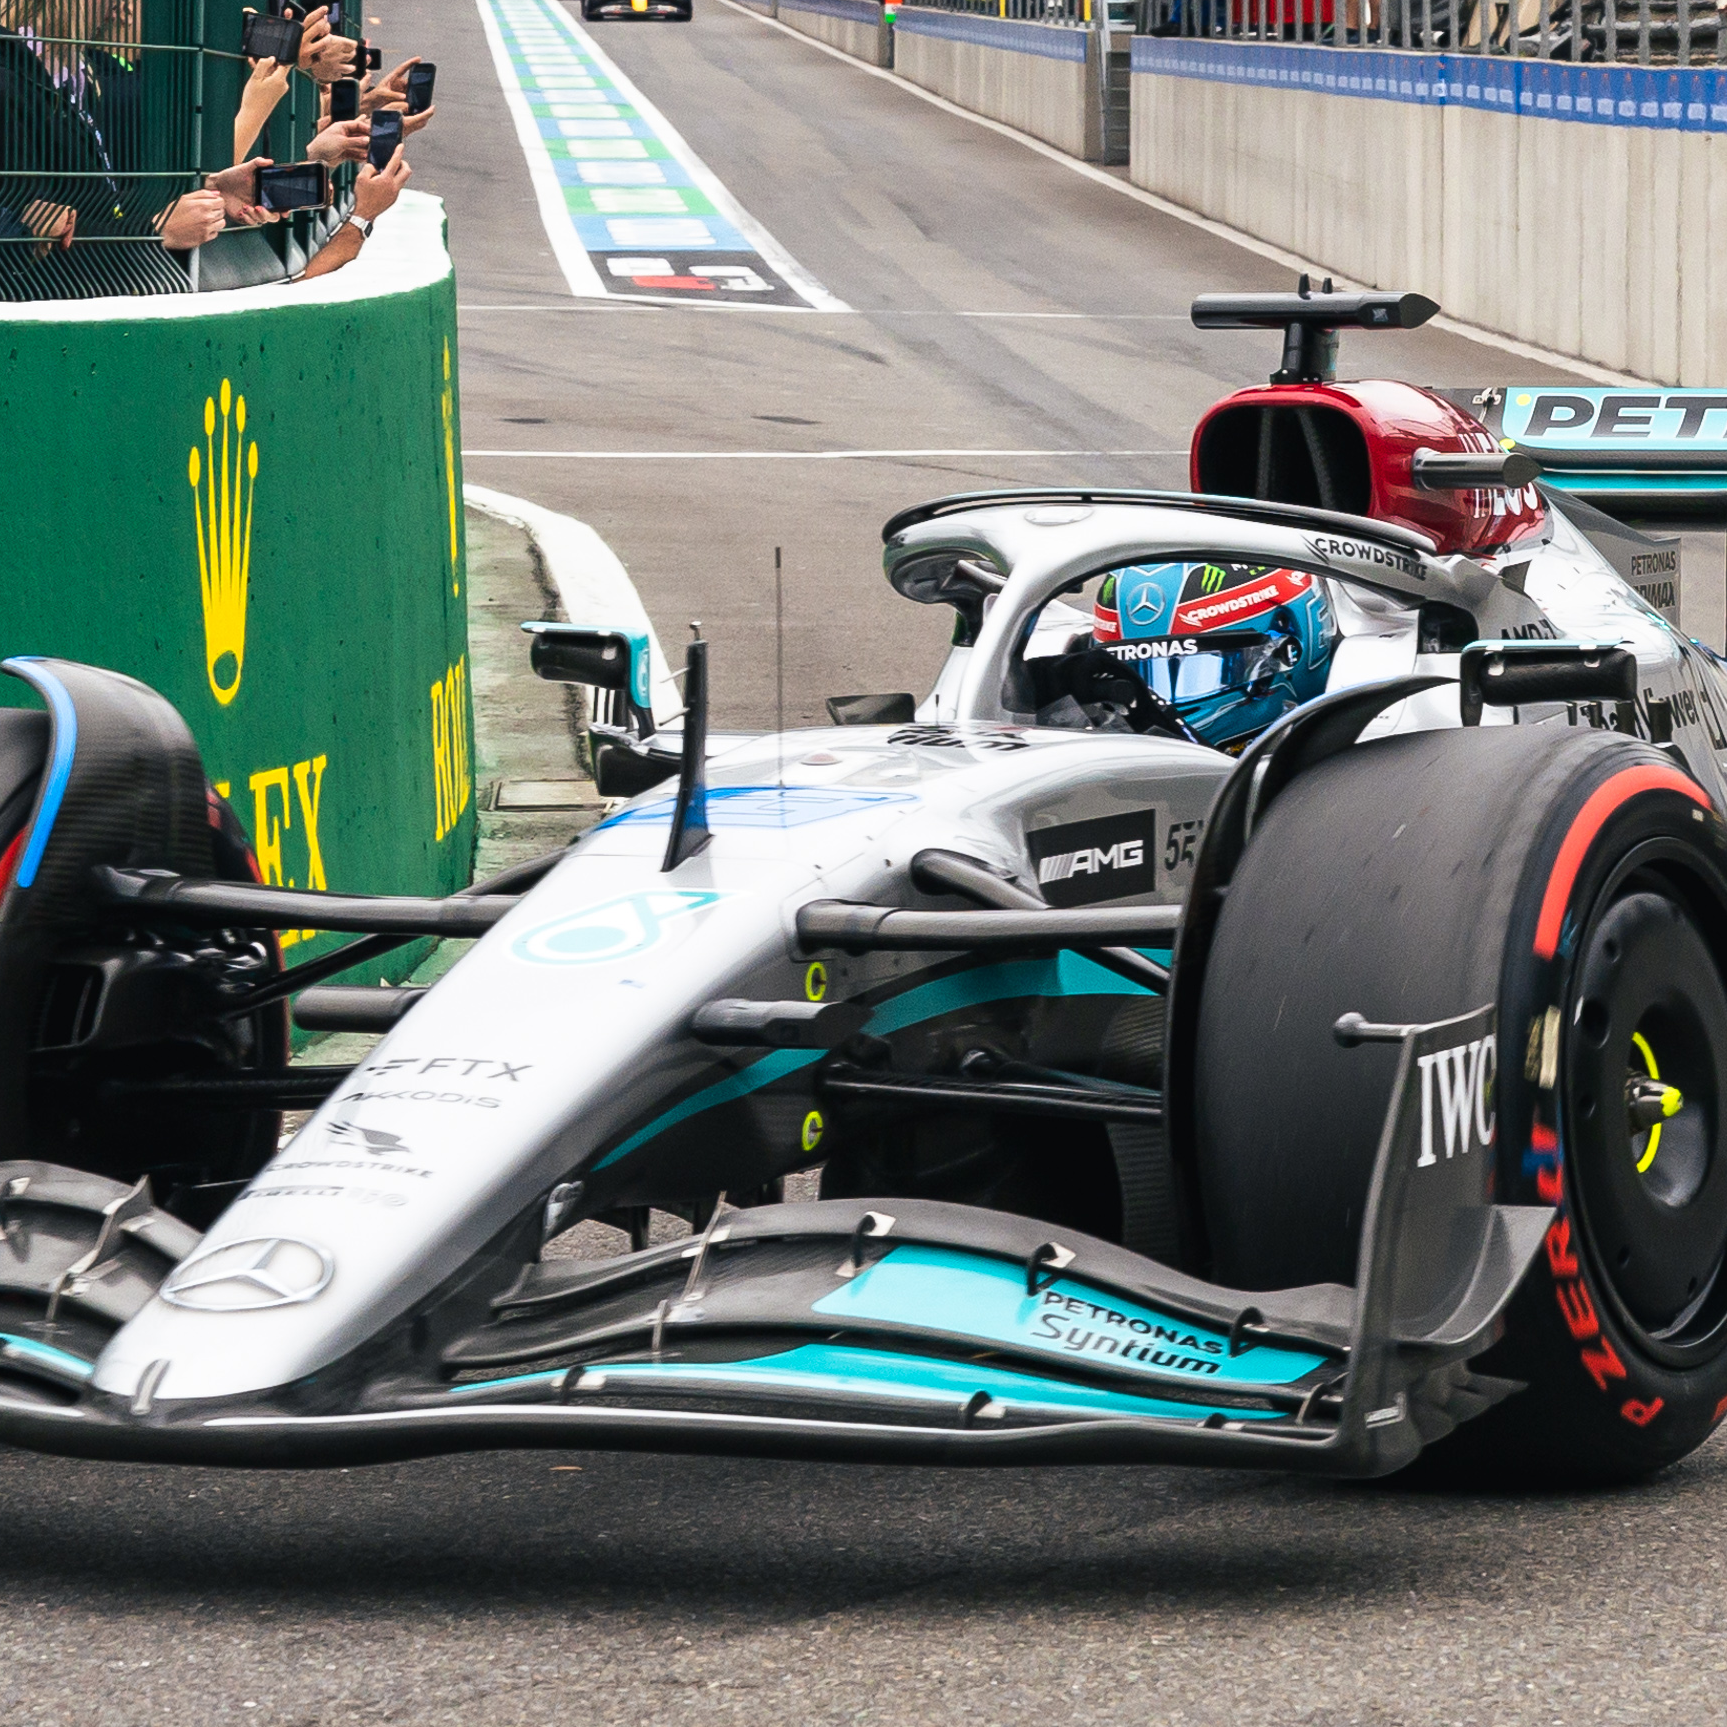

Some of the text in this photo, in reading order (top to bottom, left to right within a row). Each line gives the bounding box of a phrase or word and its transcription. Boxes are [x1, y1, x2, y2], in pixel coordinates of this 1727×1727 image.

[1314, 537, 1428, 581] CROWDSTRIKE
[1631, 551, 1676, 576] PETRONAS
[1187, 584, 1279, 620] CROWDSTRIKE
[418, 1057, 533, 1082] FTX
[1416, 1033, 1498, 1168] IWC
[1030, 1312, 1223, 1374] Syntium
[1043, 1290, 1224, 1355] PETRONAS
